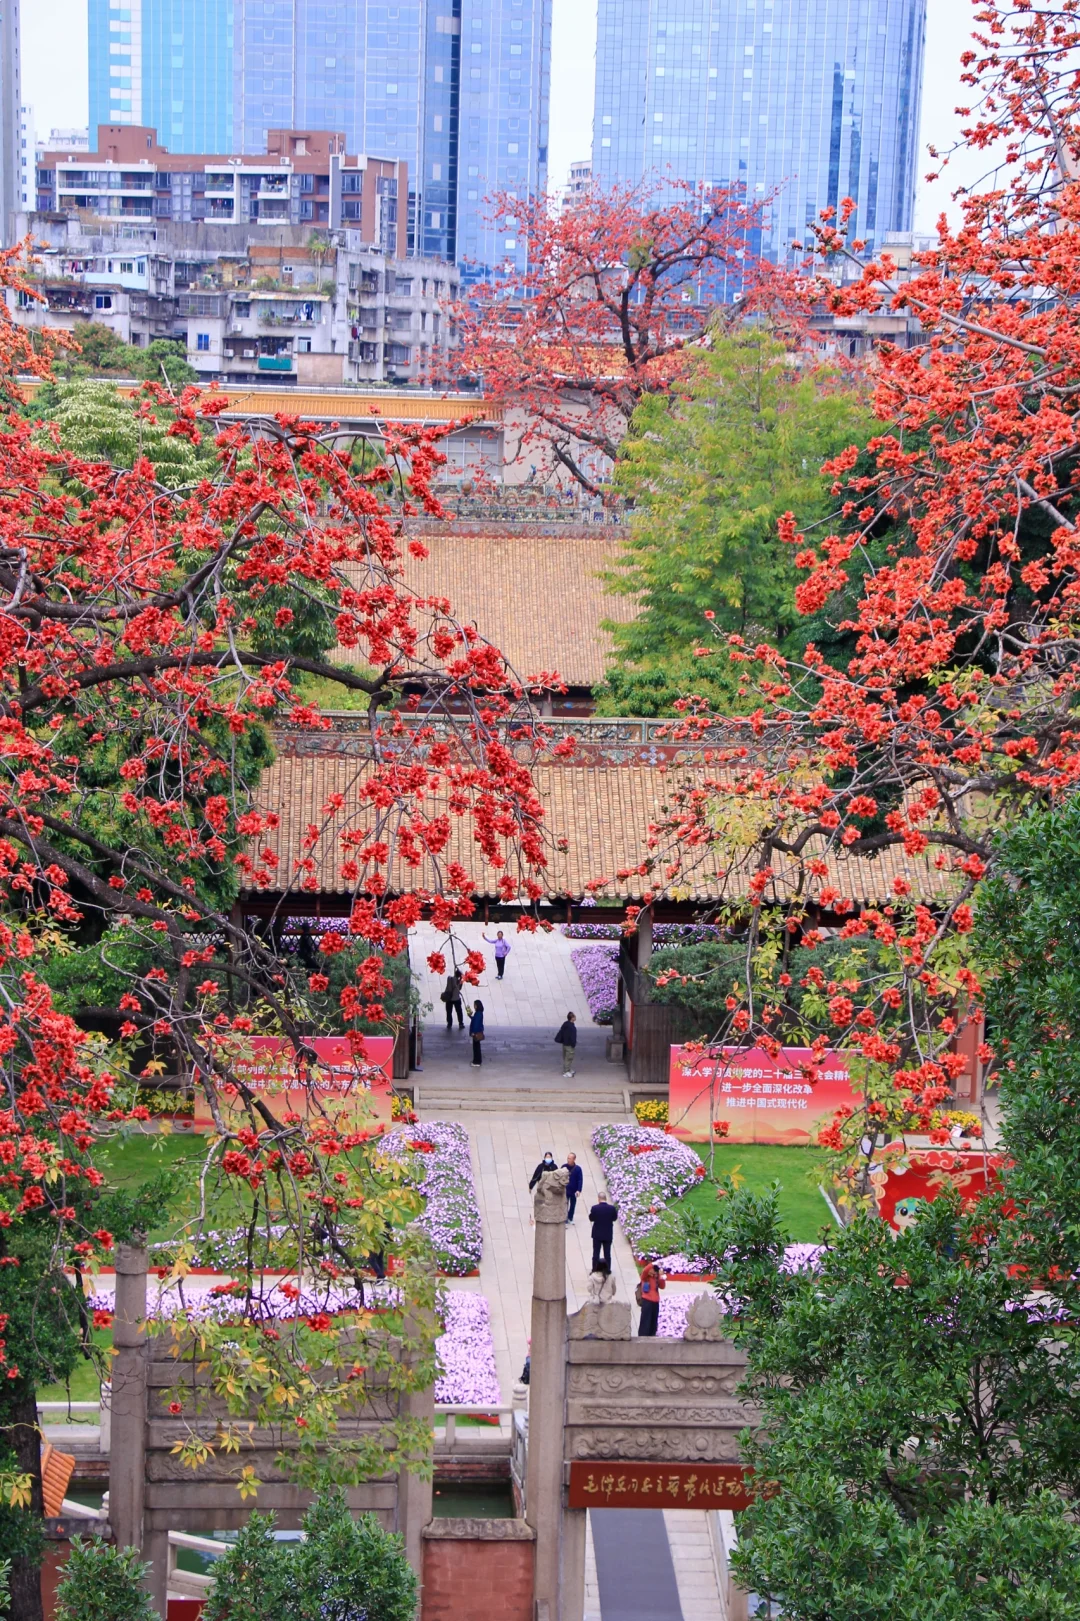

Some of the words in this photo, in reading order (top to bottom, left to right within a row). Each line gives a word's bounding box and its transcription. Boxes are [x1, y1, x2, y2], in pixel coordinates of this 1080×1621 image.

[721, 1082, 813, 1095] 进一步全面深化改革
[726, 1097, 808, 1109] 推进中国式现代化
